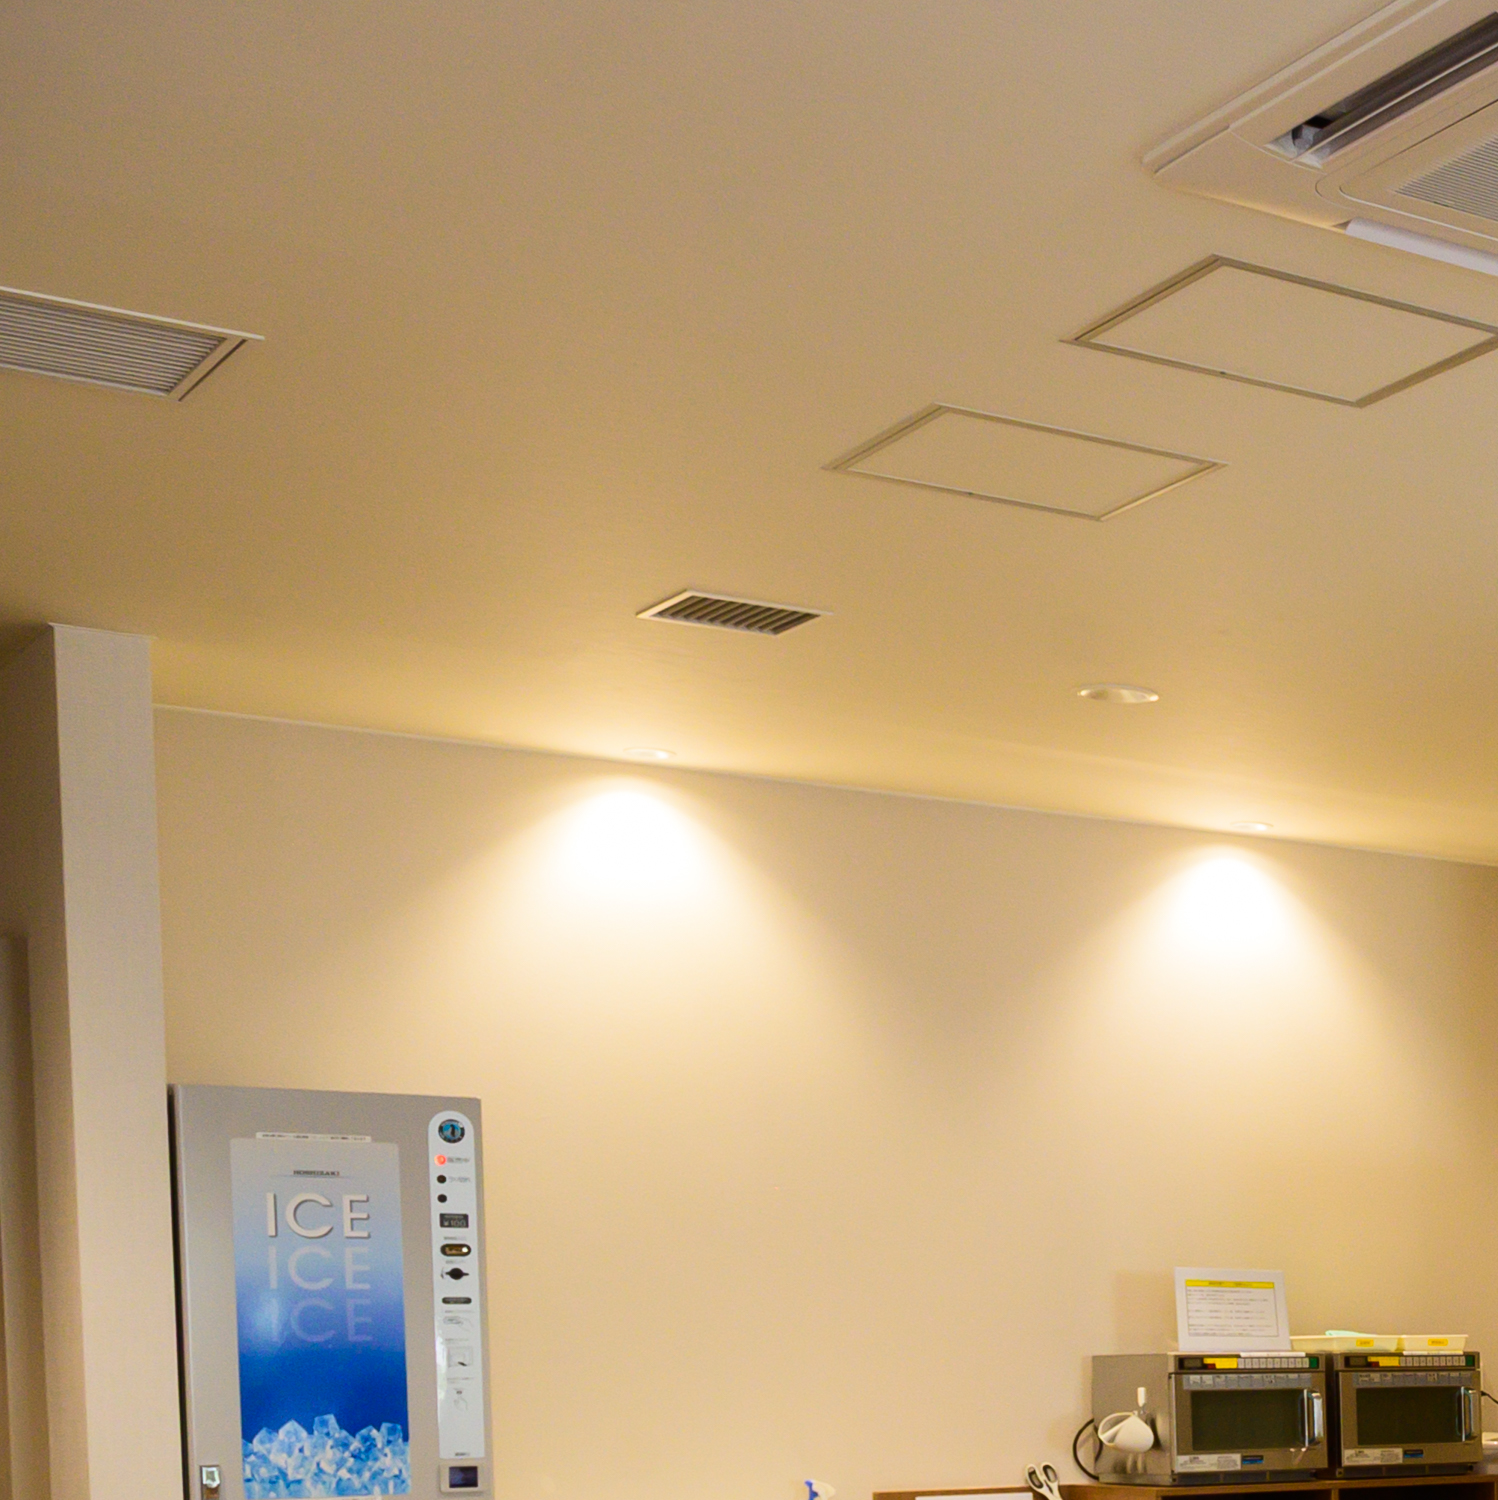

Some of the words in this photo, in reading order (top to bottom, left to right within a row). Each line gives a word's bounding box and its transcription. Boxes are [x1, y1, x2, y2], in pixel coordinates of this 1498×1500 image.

[267, 1193, 369, 1238] ICE
[268, 1246, 370, 1290] ICE
[272, 1298, 373, 1342] ICE
